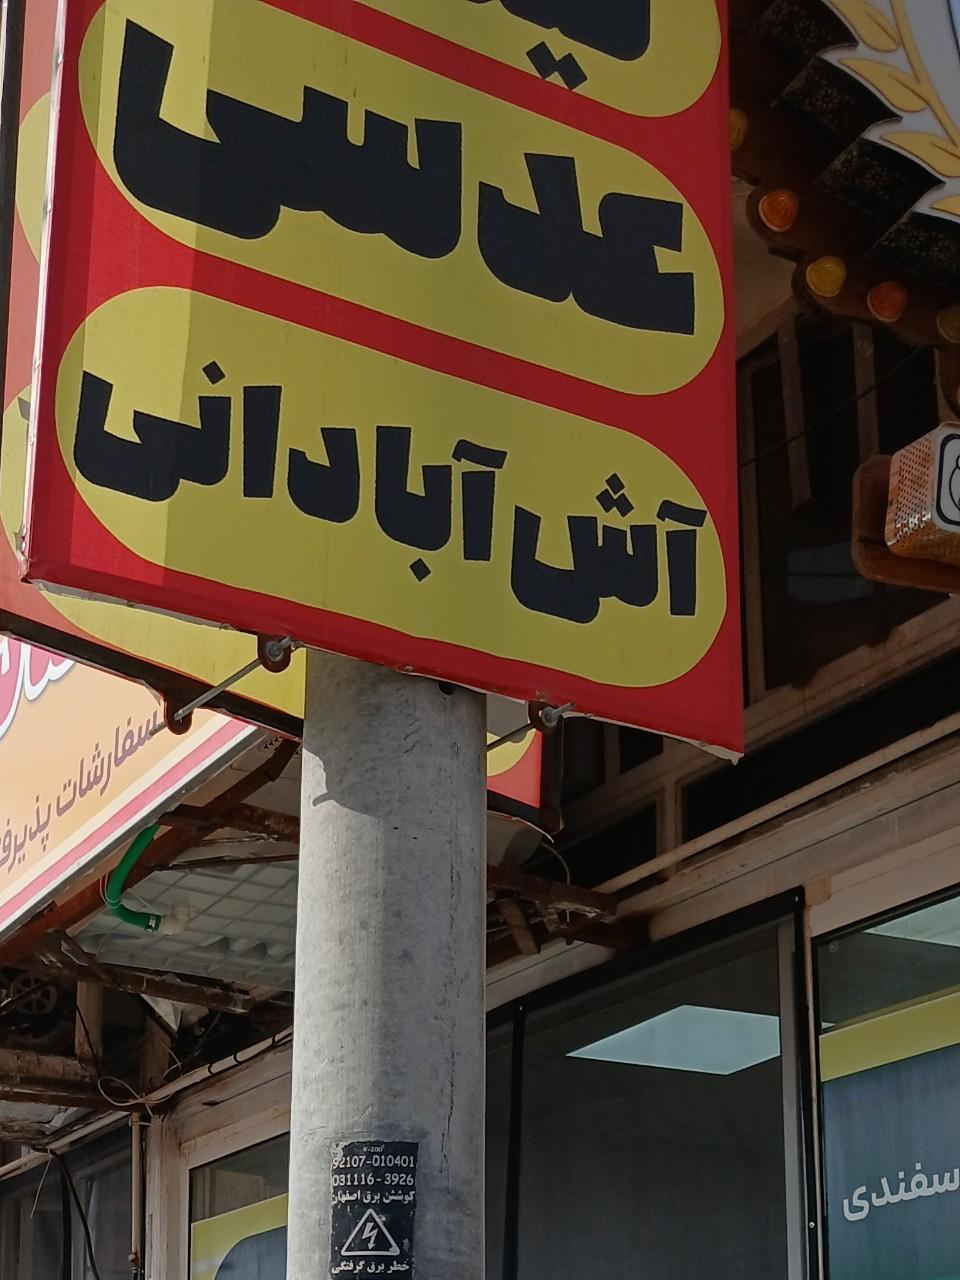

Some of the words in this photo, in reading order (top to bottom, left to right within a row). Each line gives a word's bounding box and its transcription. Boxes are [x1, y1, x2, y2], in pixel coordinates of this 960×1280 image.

[112, 19, 695, 335] عدسی
[73, 360, 507, 583] آبادانی
[511, 473, 707, 624] آش
[843, 1162, 960, 1221] سفندی
[367, 1262, 385, 1274] برق
[387, 1259, 410, 1274] خطر
